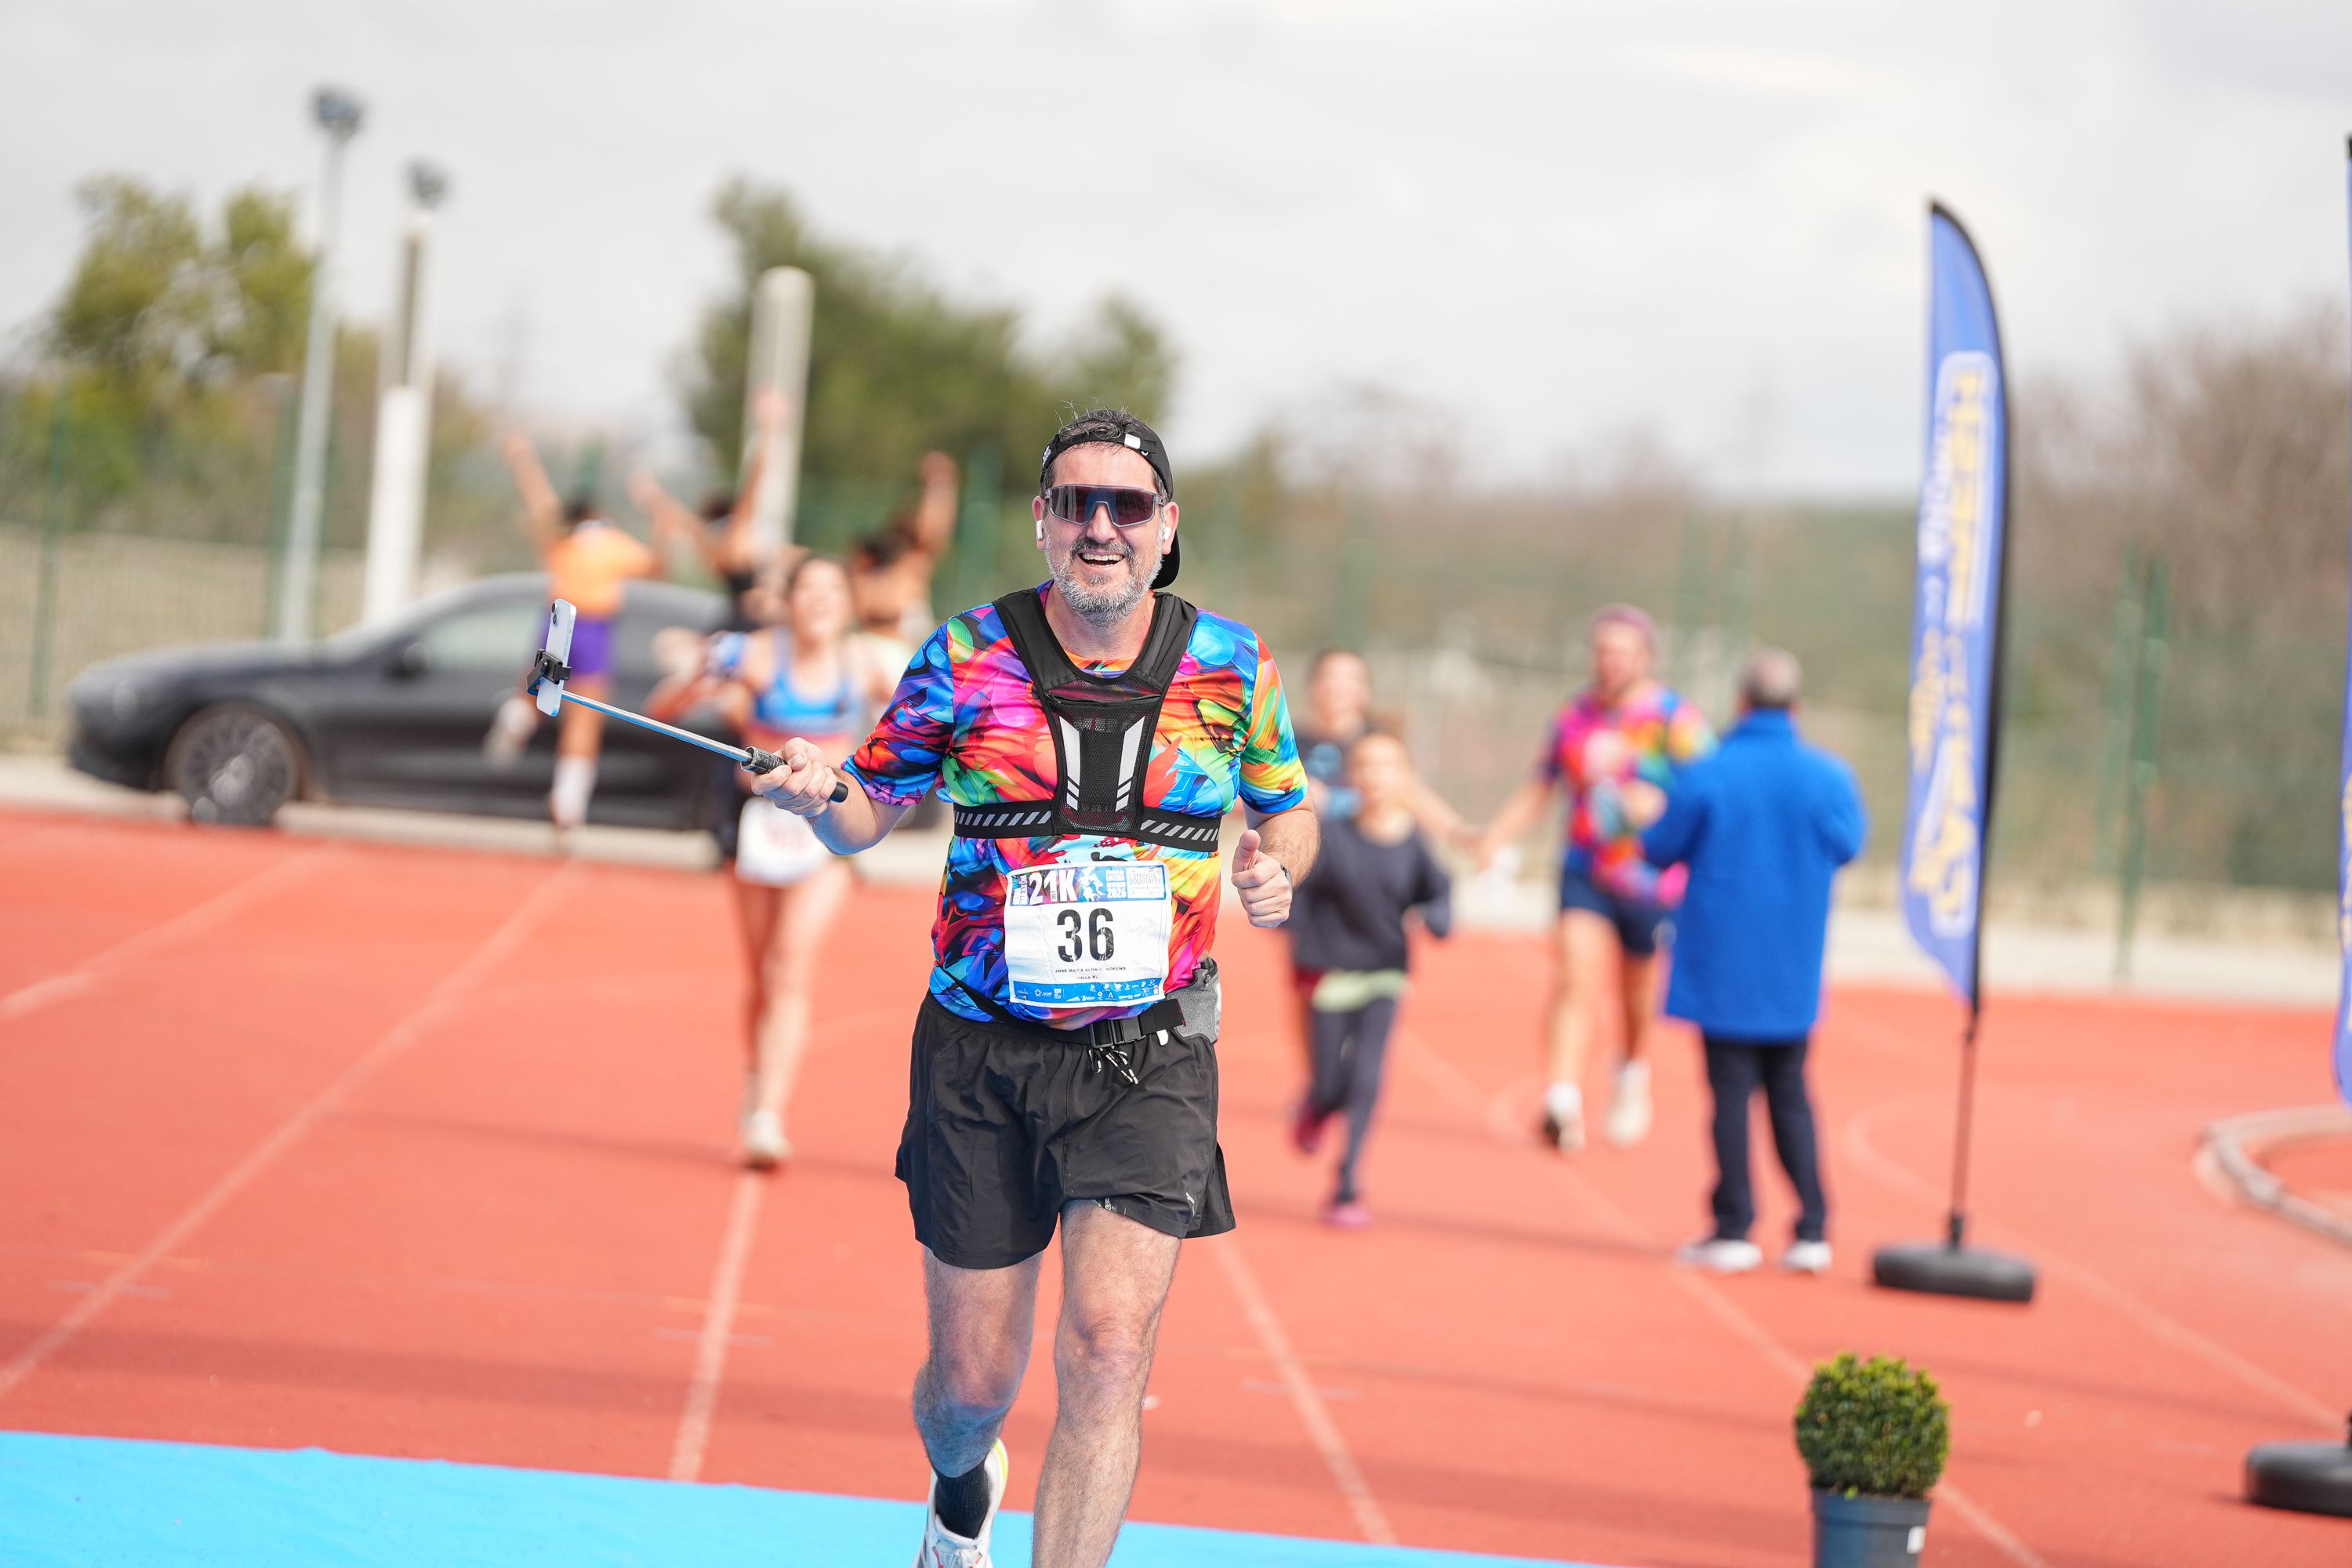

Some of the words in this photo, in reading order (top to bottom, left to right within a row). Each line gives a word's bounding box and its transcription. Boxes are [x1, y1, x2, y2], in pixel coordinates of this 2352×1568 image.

[1029, 869, 1077, 906] 21K
[1107, 887, 1127, 898] 2026
[1057, 908, 1114, 963] 36
